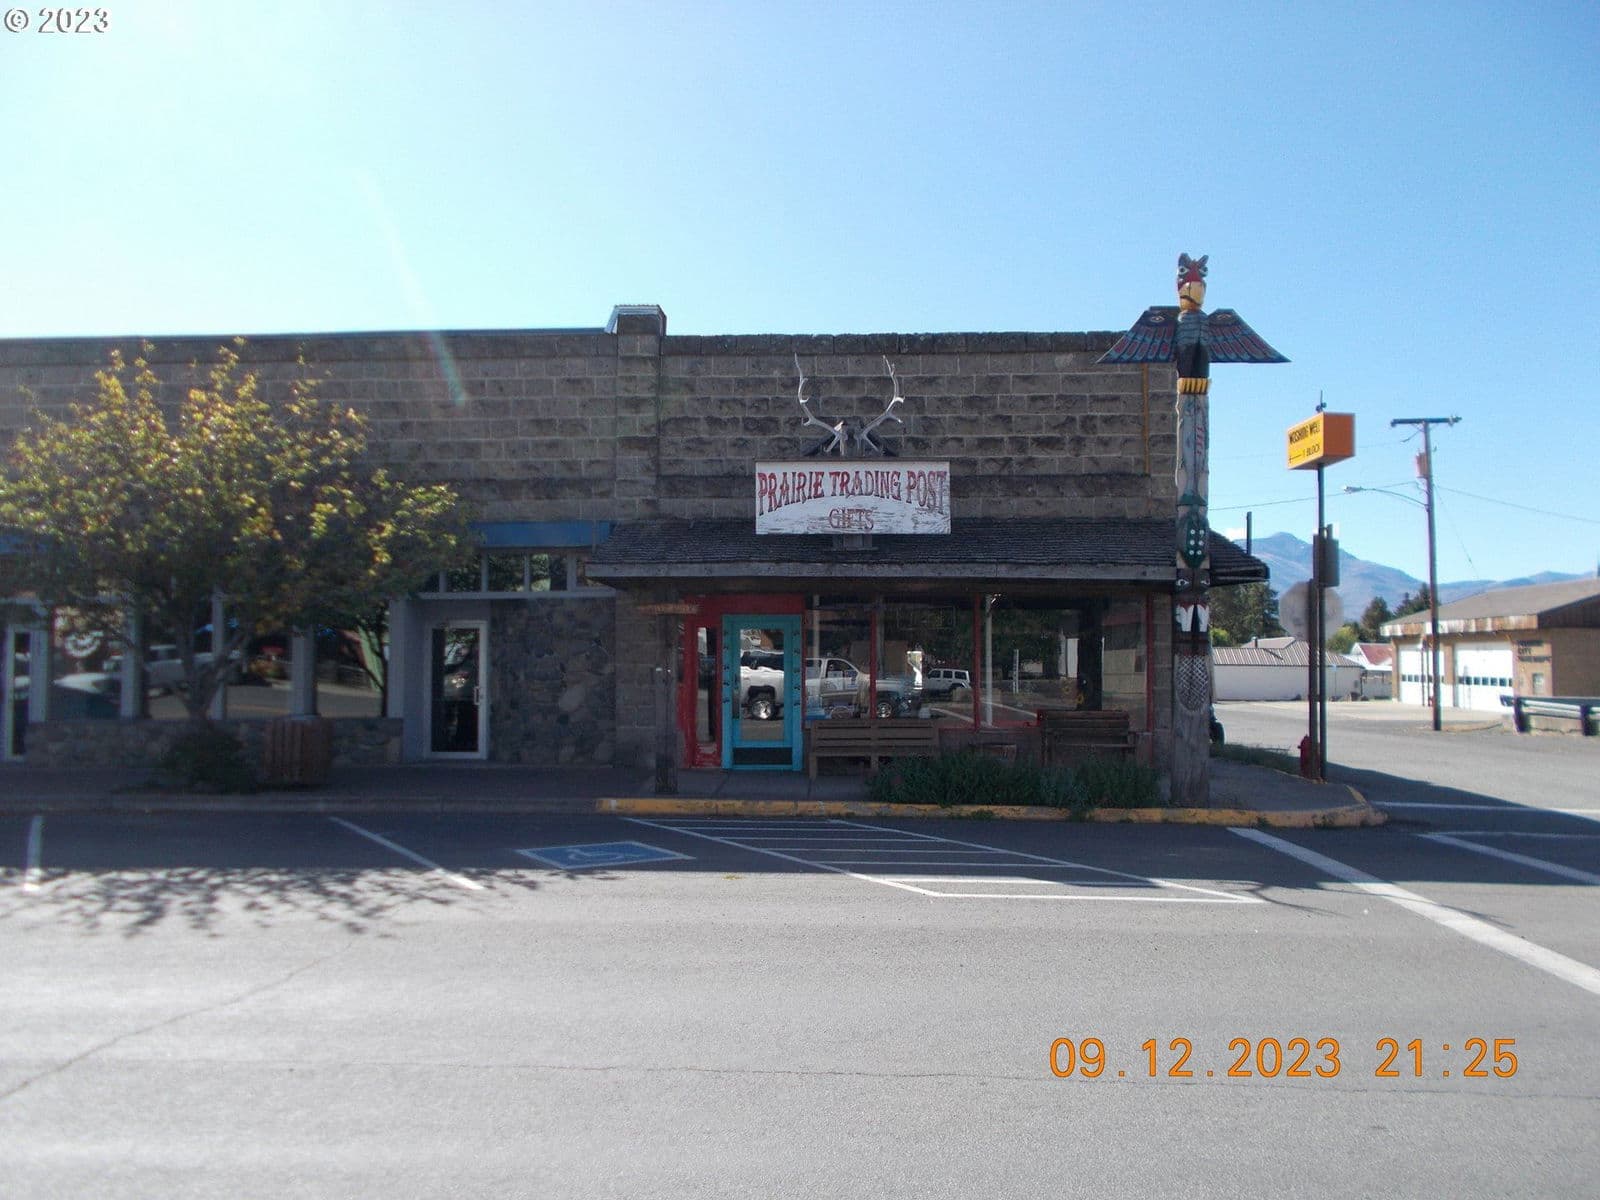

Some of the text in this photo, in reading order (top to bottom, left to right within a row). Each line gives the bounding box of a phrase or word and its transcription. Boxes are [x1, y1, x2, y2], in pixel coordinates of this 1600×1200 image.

[757, 469, 947, 516] PRAIRIE TRADING POST
[828, 507, 874, 530] GIFTS
